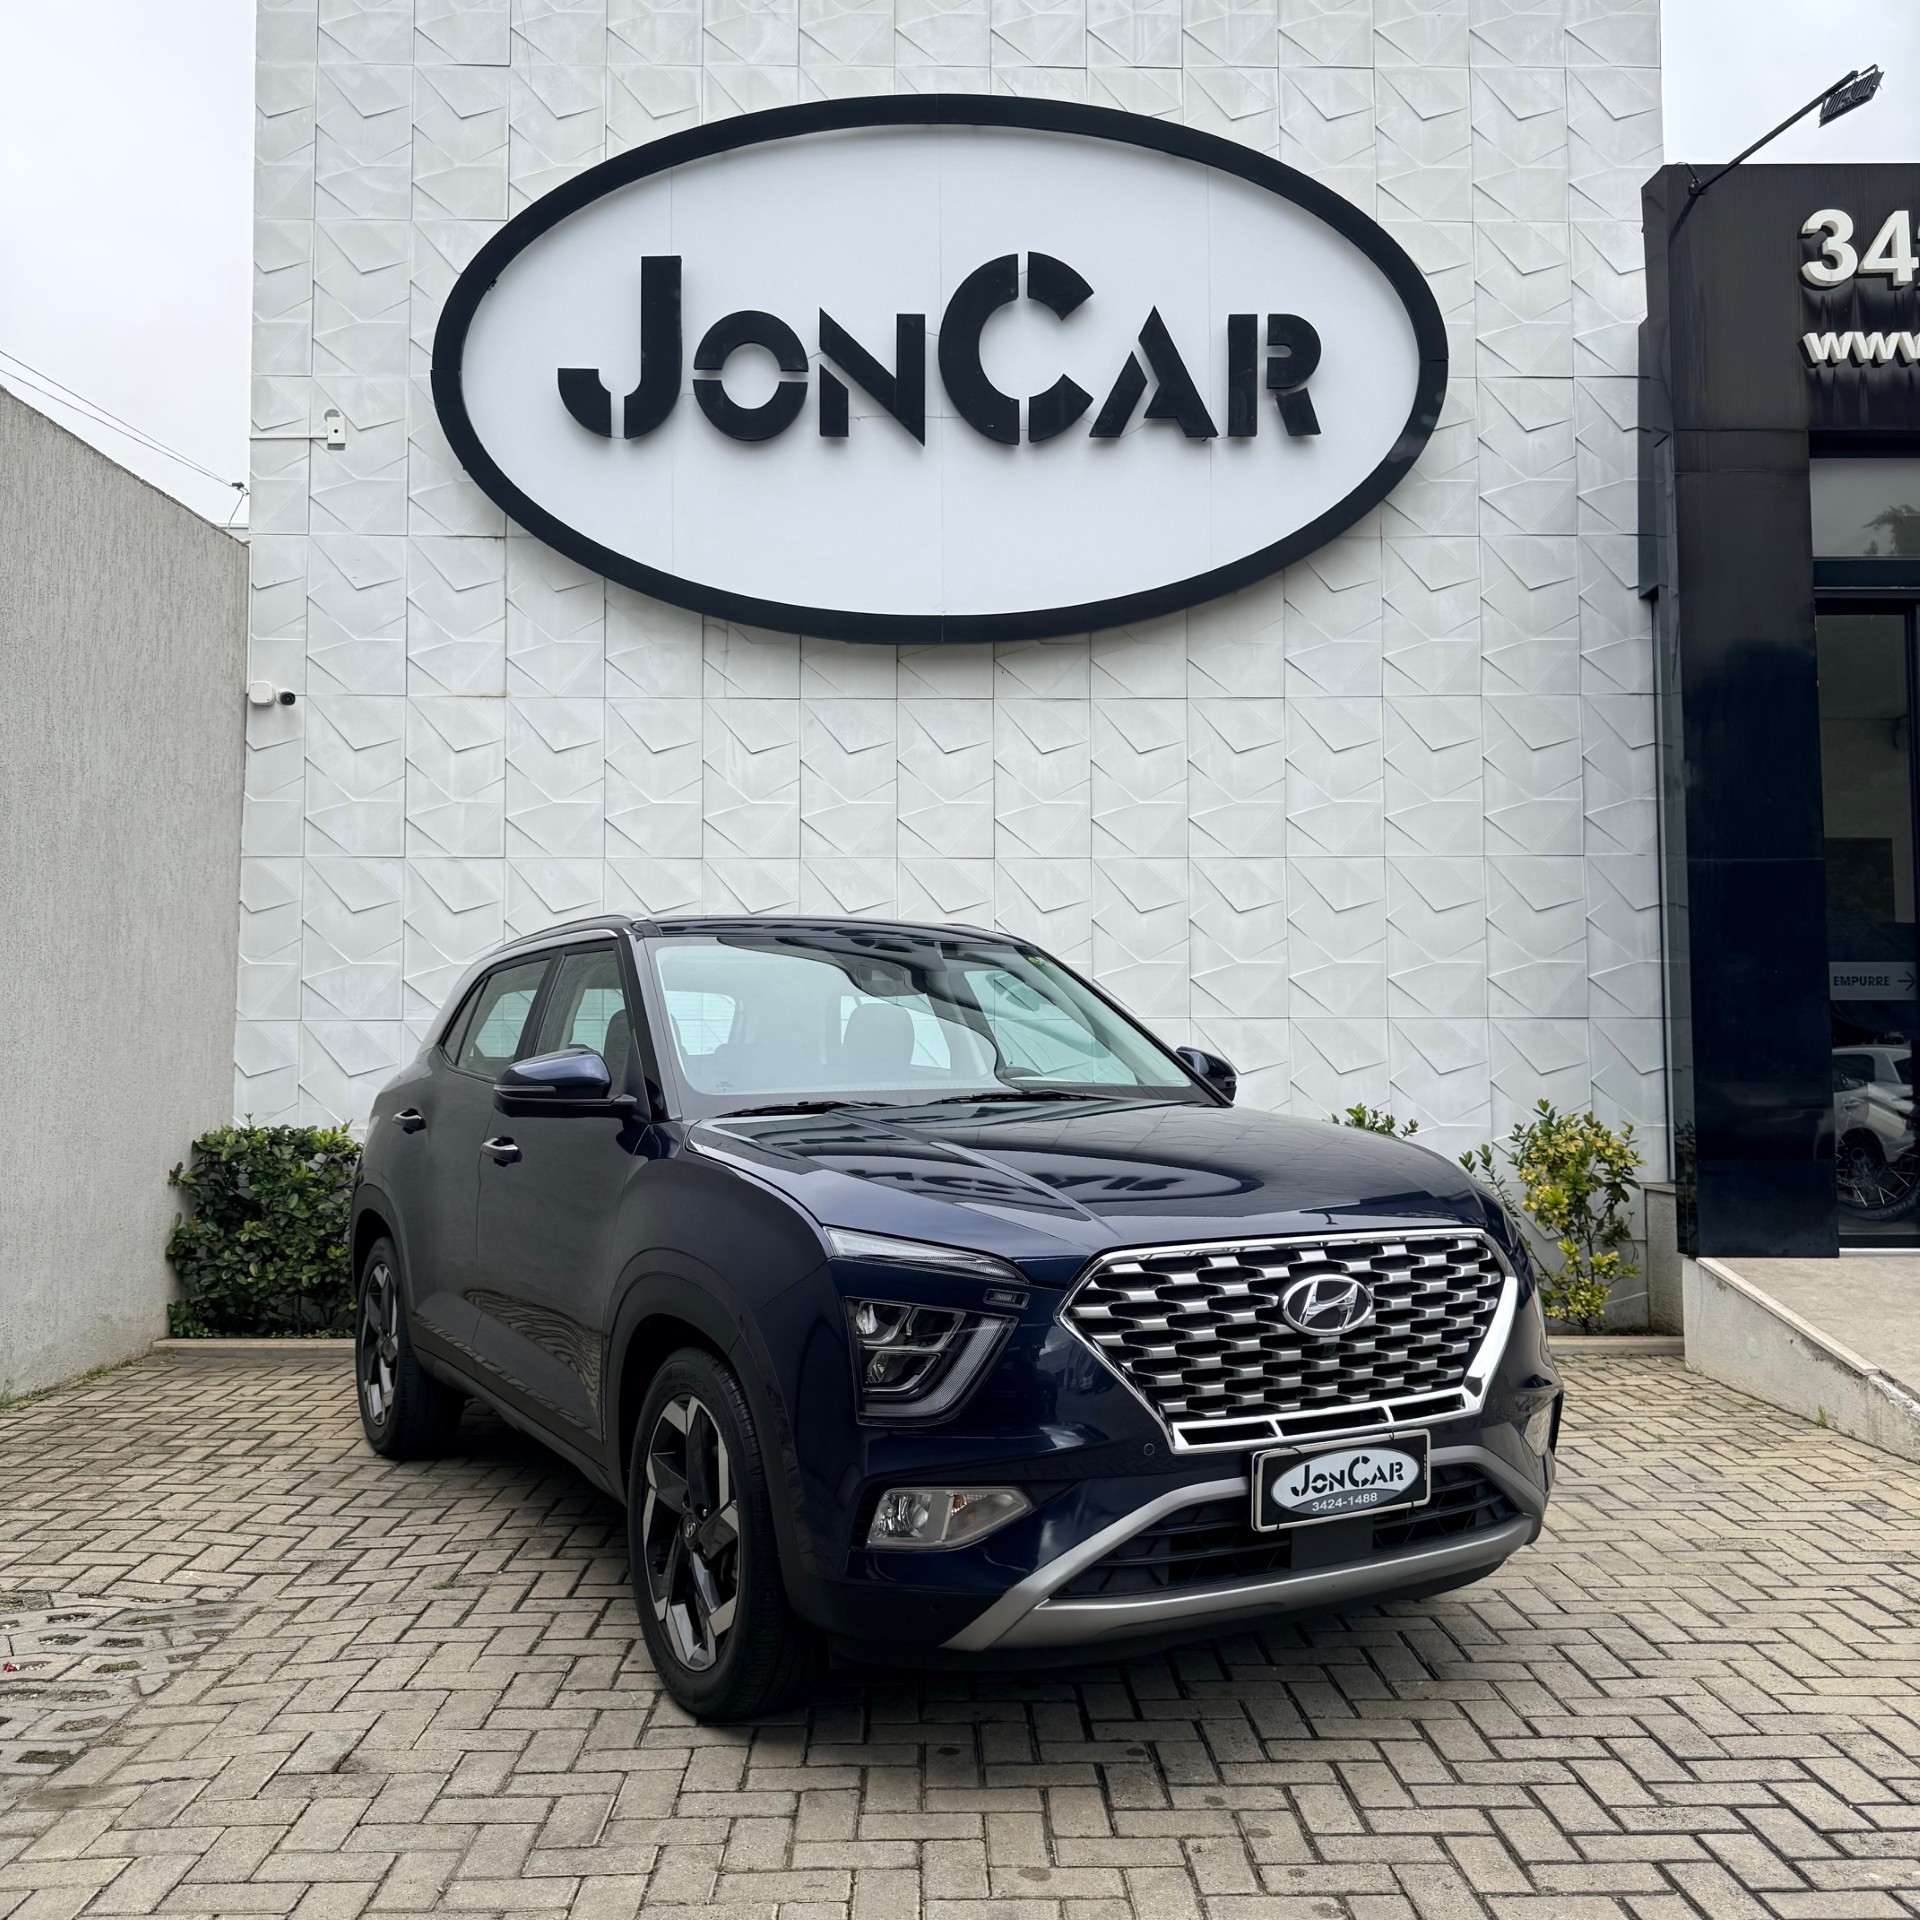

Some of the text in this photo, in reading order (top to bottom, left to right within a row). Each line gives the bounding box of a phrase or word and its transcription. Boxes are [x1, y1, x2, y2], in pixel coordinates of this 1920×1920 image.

[1801, 208, 1920, 287] 34
[1833, 975, 1890, 987] EMPURRE
[1312, 1492, 1378, 1512] 3424-1488
